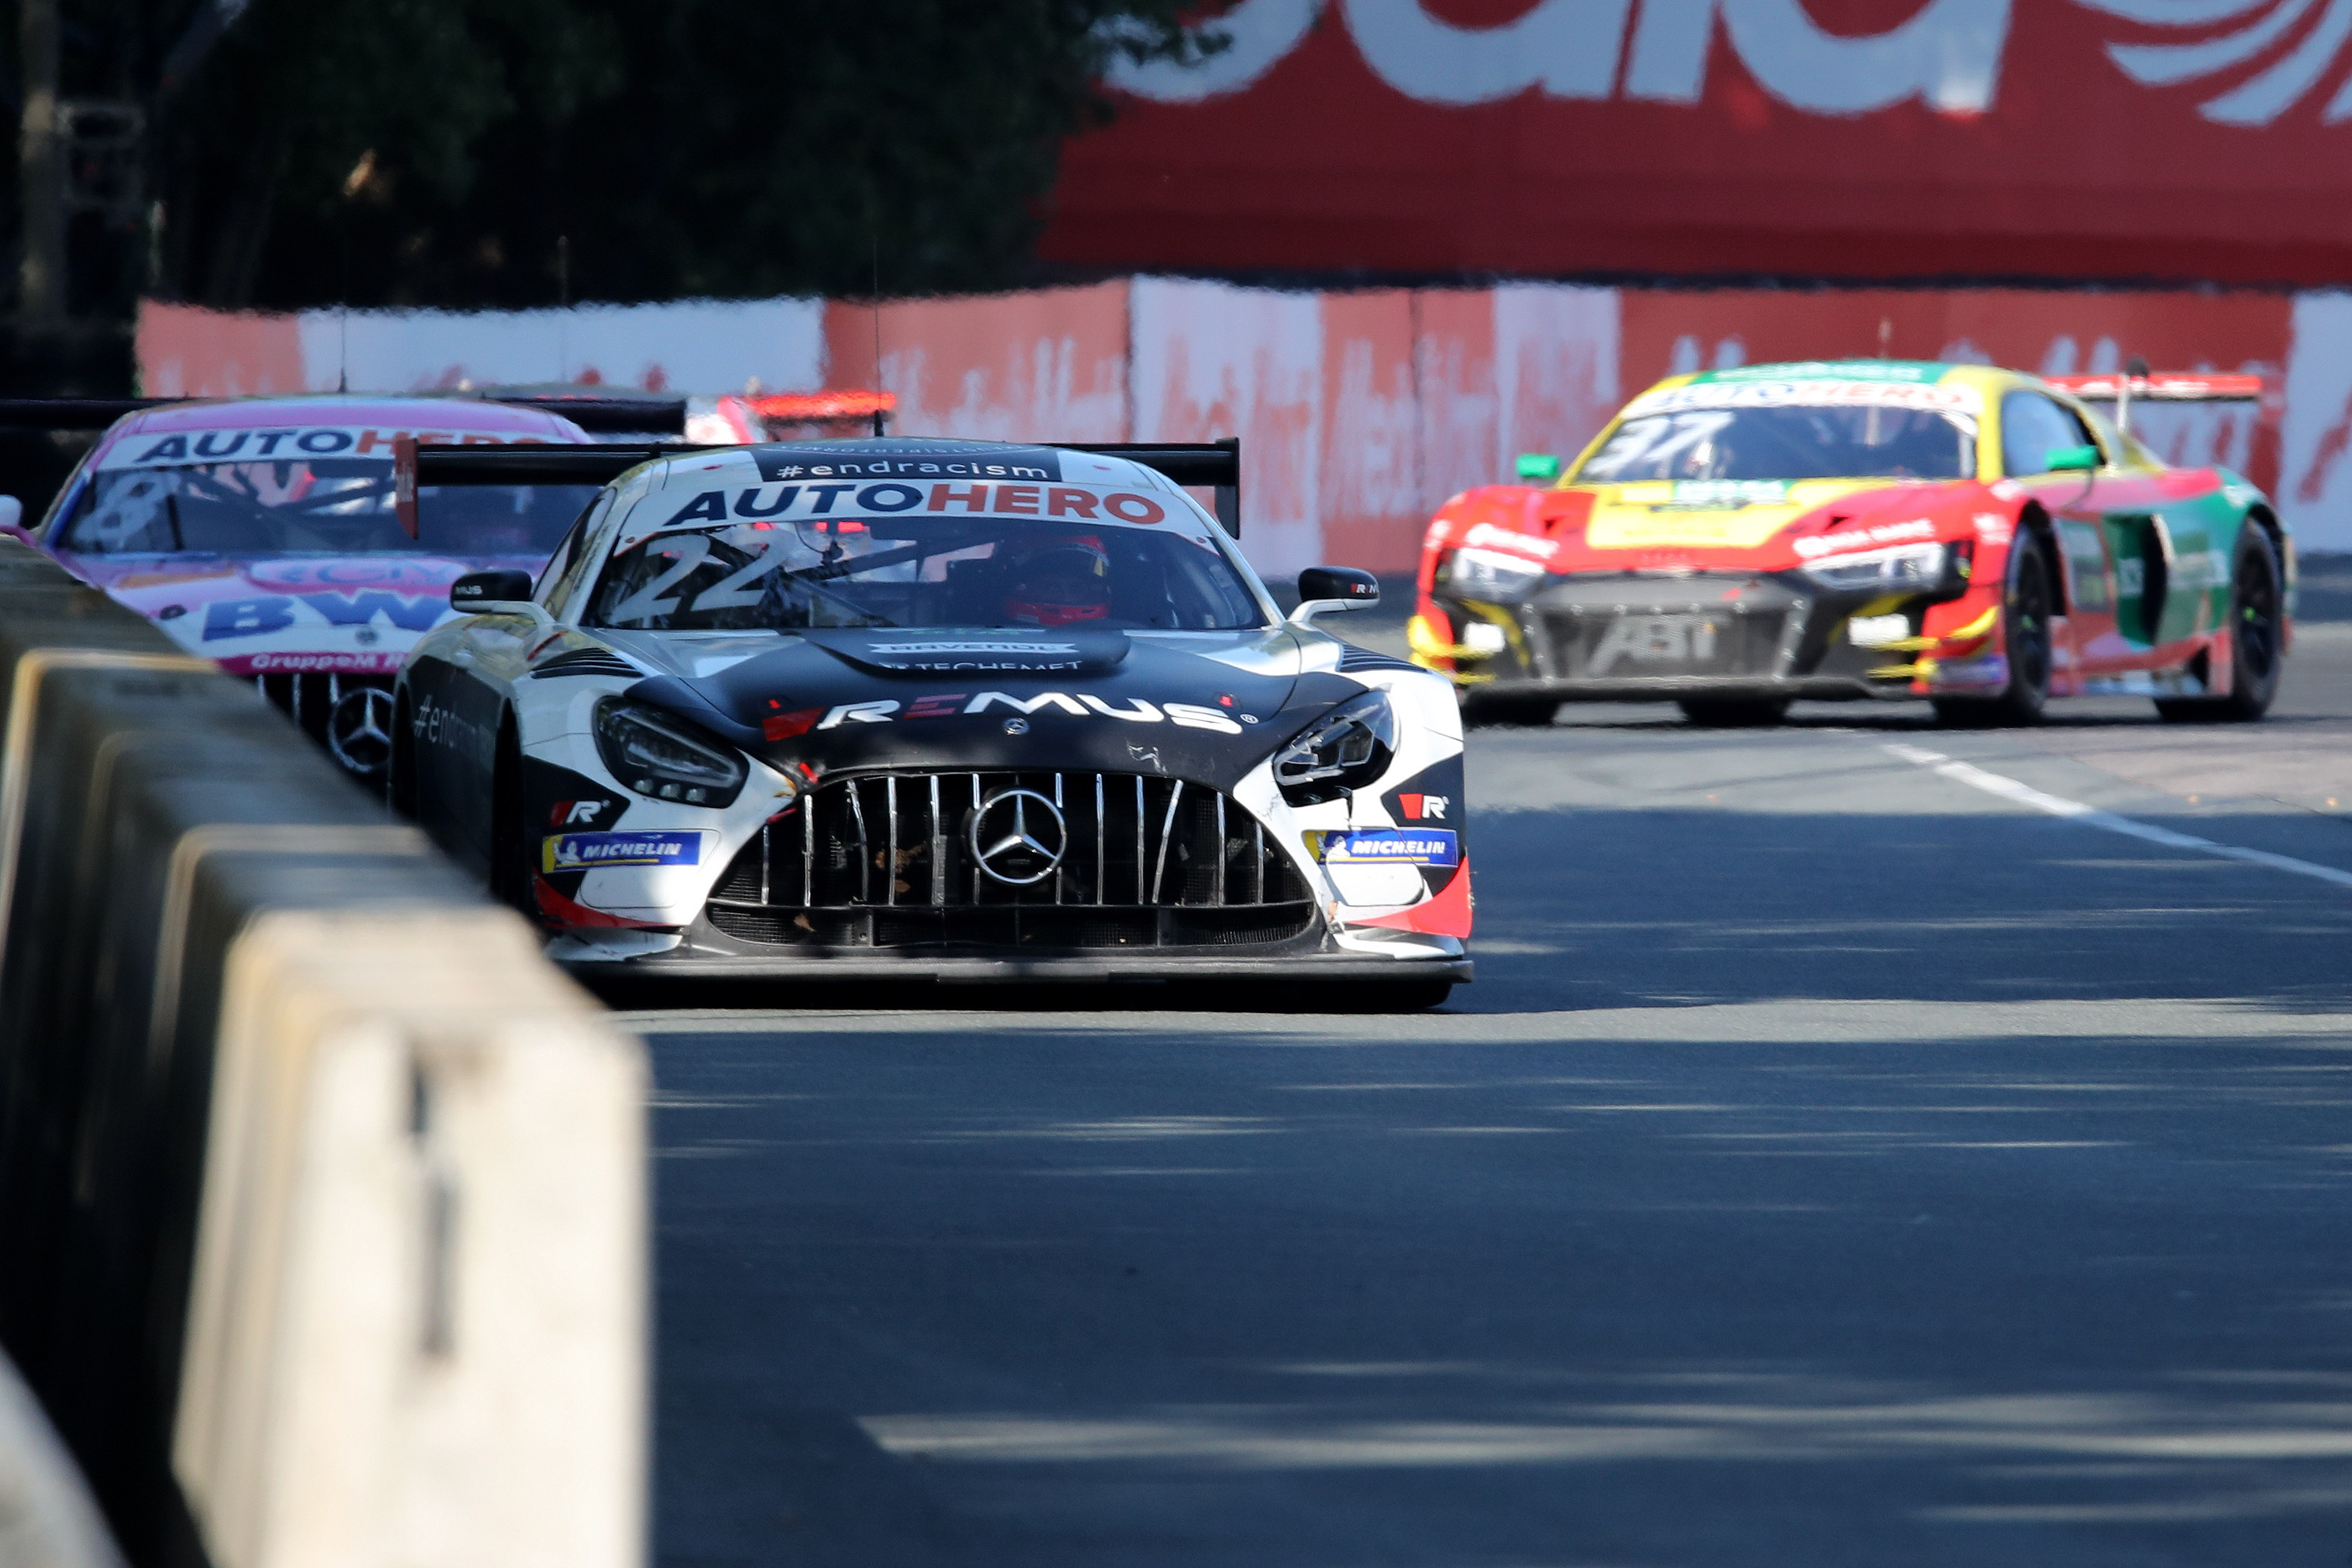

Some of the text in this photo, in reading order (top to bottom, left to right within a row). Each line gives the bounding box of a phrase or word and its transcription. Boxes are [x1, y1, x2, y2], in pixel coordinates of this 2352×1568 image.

[135, 430, 548, 463] AUTOH
[776, 460, 1048, 479] #endracism
[663, 483, 1164, 526] AUTOHERO
[609, 531, 797, 624] 22
[202, 590, 453, 642] BW
[251, 652, 377, 671] GruppeM
[1588, 614, 1732, 677] ABT
[583, 842, 682, 858] MICHELIN
[1352, 840, 1446, 854] MICHELIN
